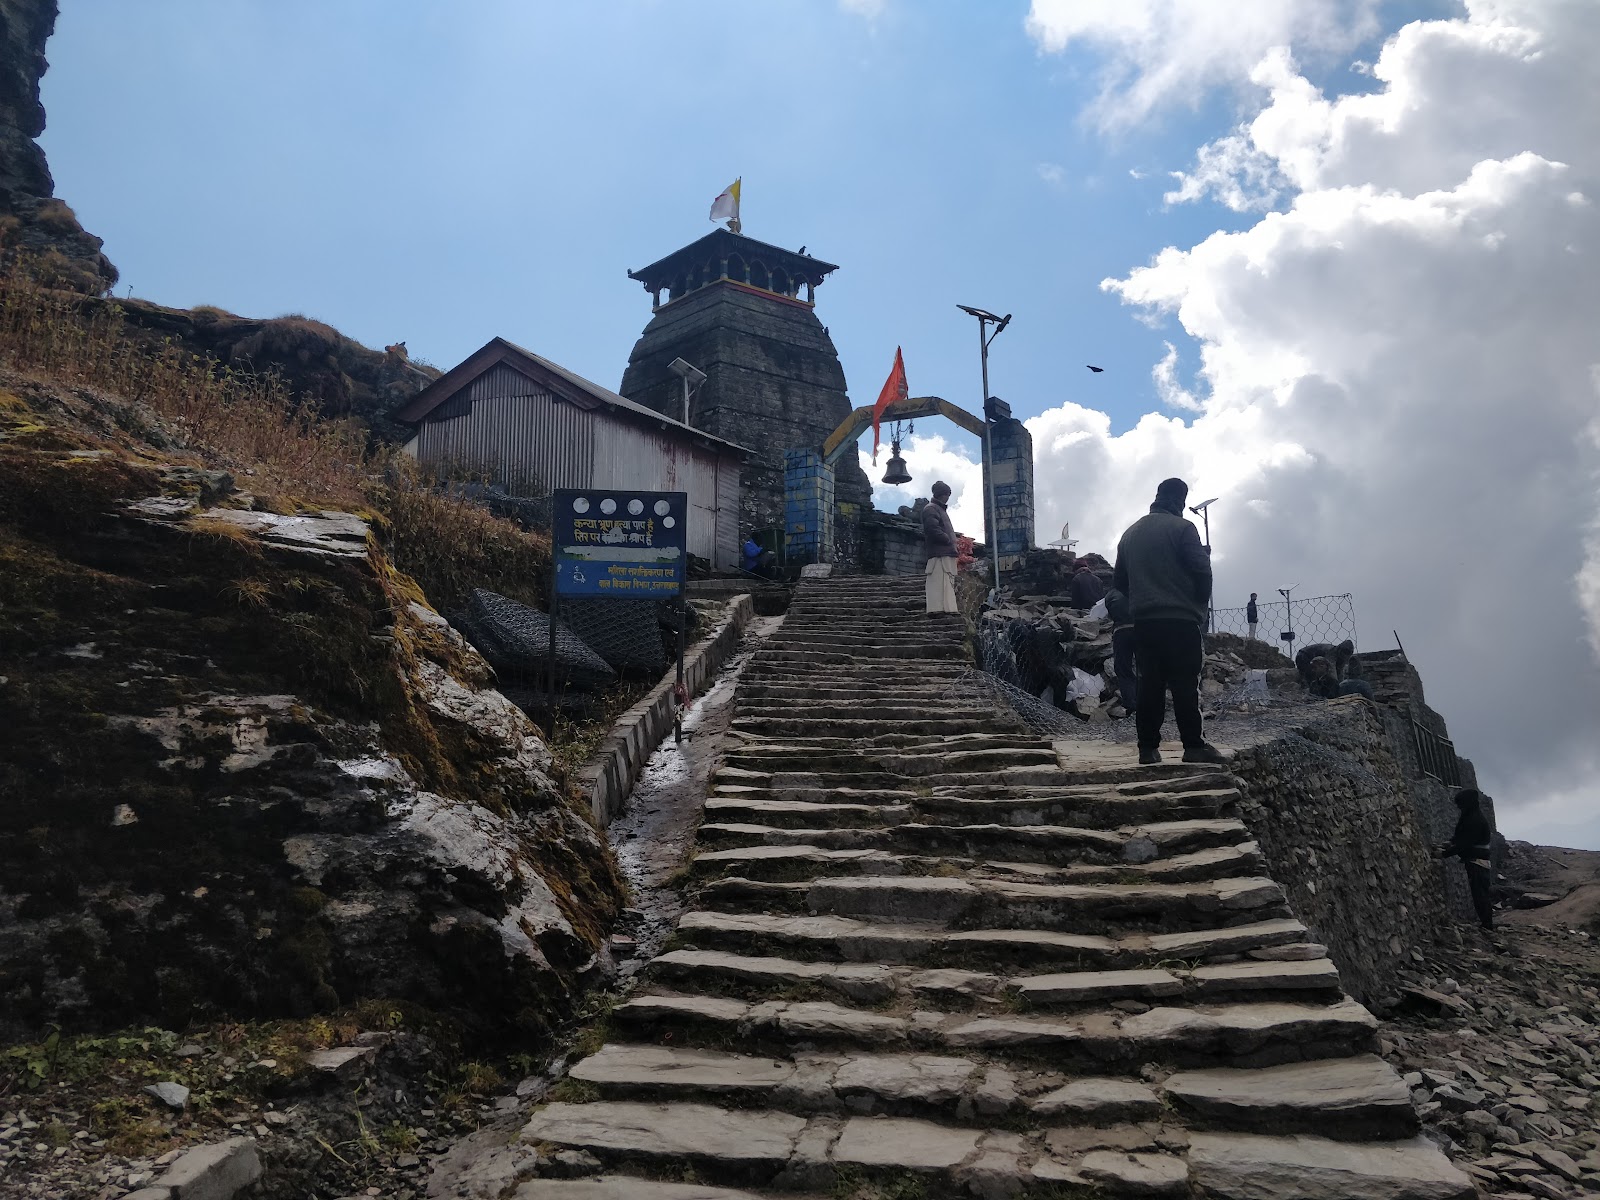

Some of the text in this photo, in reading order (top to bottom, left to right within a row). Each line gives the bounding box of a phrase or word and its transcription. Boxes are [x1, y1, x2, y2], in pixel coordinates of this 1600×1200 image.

[574, 518, 597, 529] कन्या
[632, 520, 646, 530] पाप
[574, 528, 589, 543] सिर
[589, 532, 601, 543] पर
[608, 564, 627, 576] महिला
[664, 568, 675, 577] एवं
[598, 579, 611, 589] बाल
[612, 577, 631, 589] विकास
